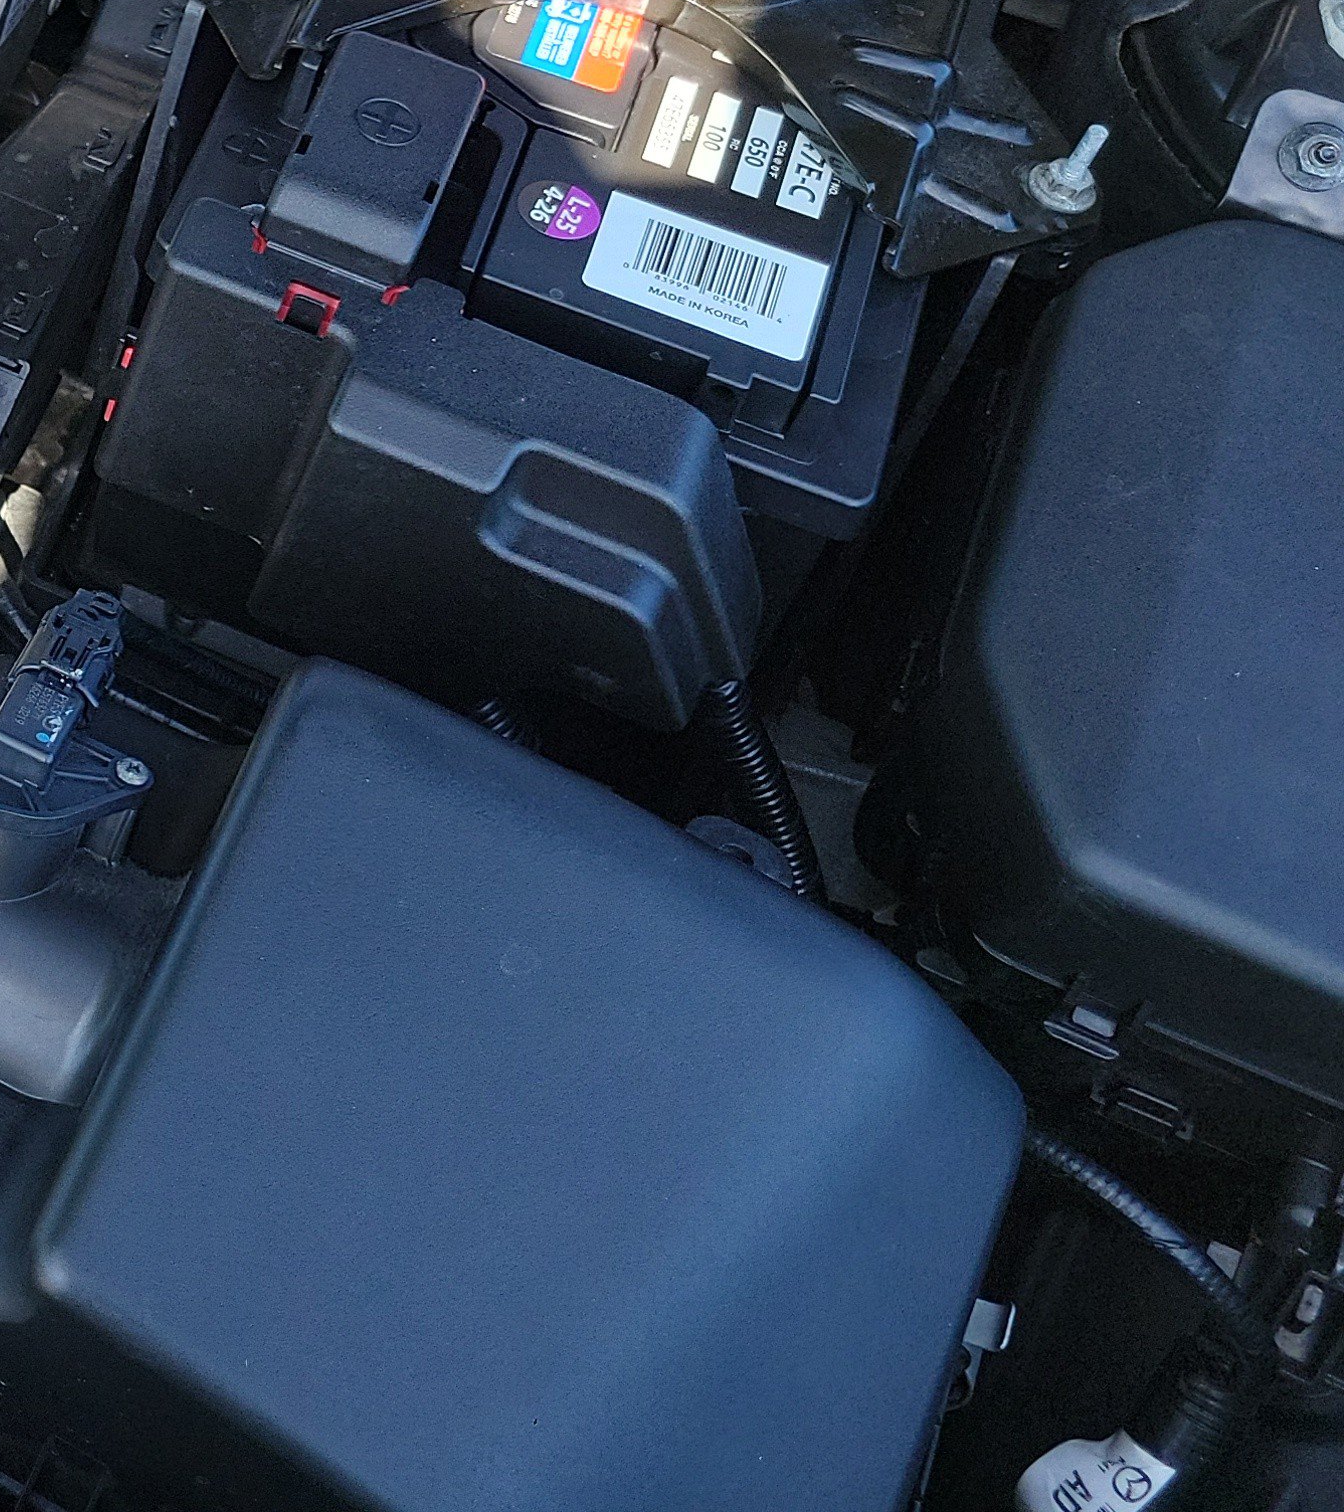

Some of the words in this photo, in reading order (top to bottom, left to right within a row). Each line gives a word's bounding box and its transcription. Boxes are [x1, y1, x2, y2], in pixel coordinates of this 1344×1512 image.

[680, 113, 699, 144] SERIAL
[701, 122, 727, 153] 100
[728, 138, 740, 150] RC
[742, 135, 770, 168] 650
[773, 139, 787, 159] CCA
[529, 185, 563, 225] 4-26
[556, 185, 592, 235] L-25
[647, 285, 686, 305] MADE
[687, 300, 701, 311] IN
[703, 305, 750, 328] KOREA
[712, 294, 749, 312] 02146
[775, 316, 782, 324] 4
